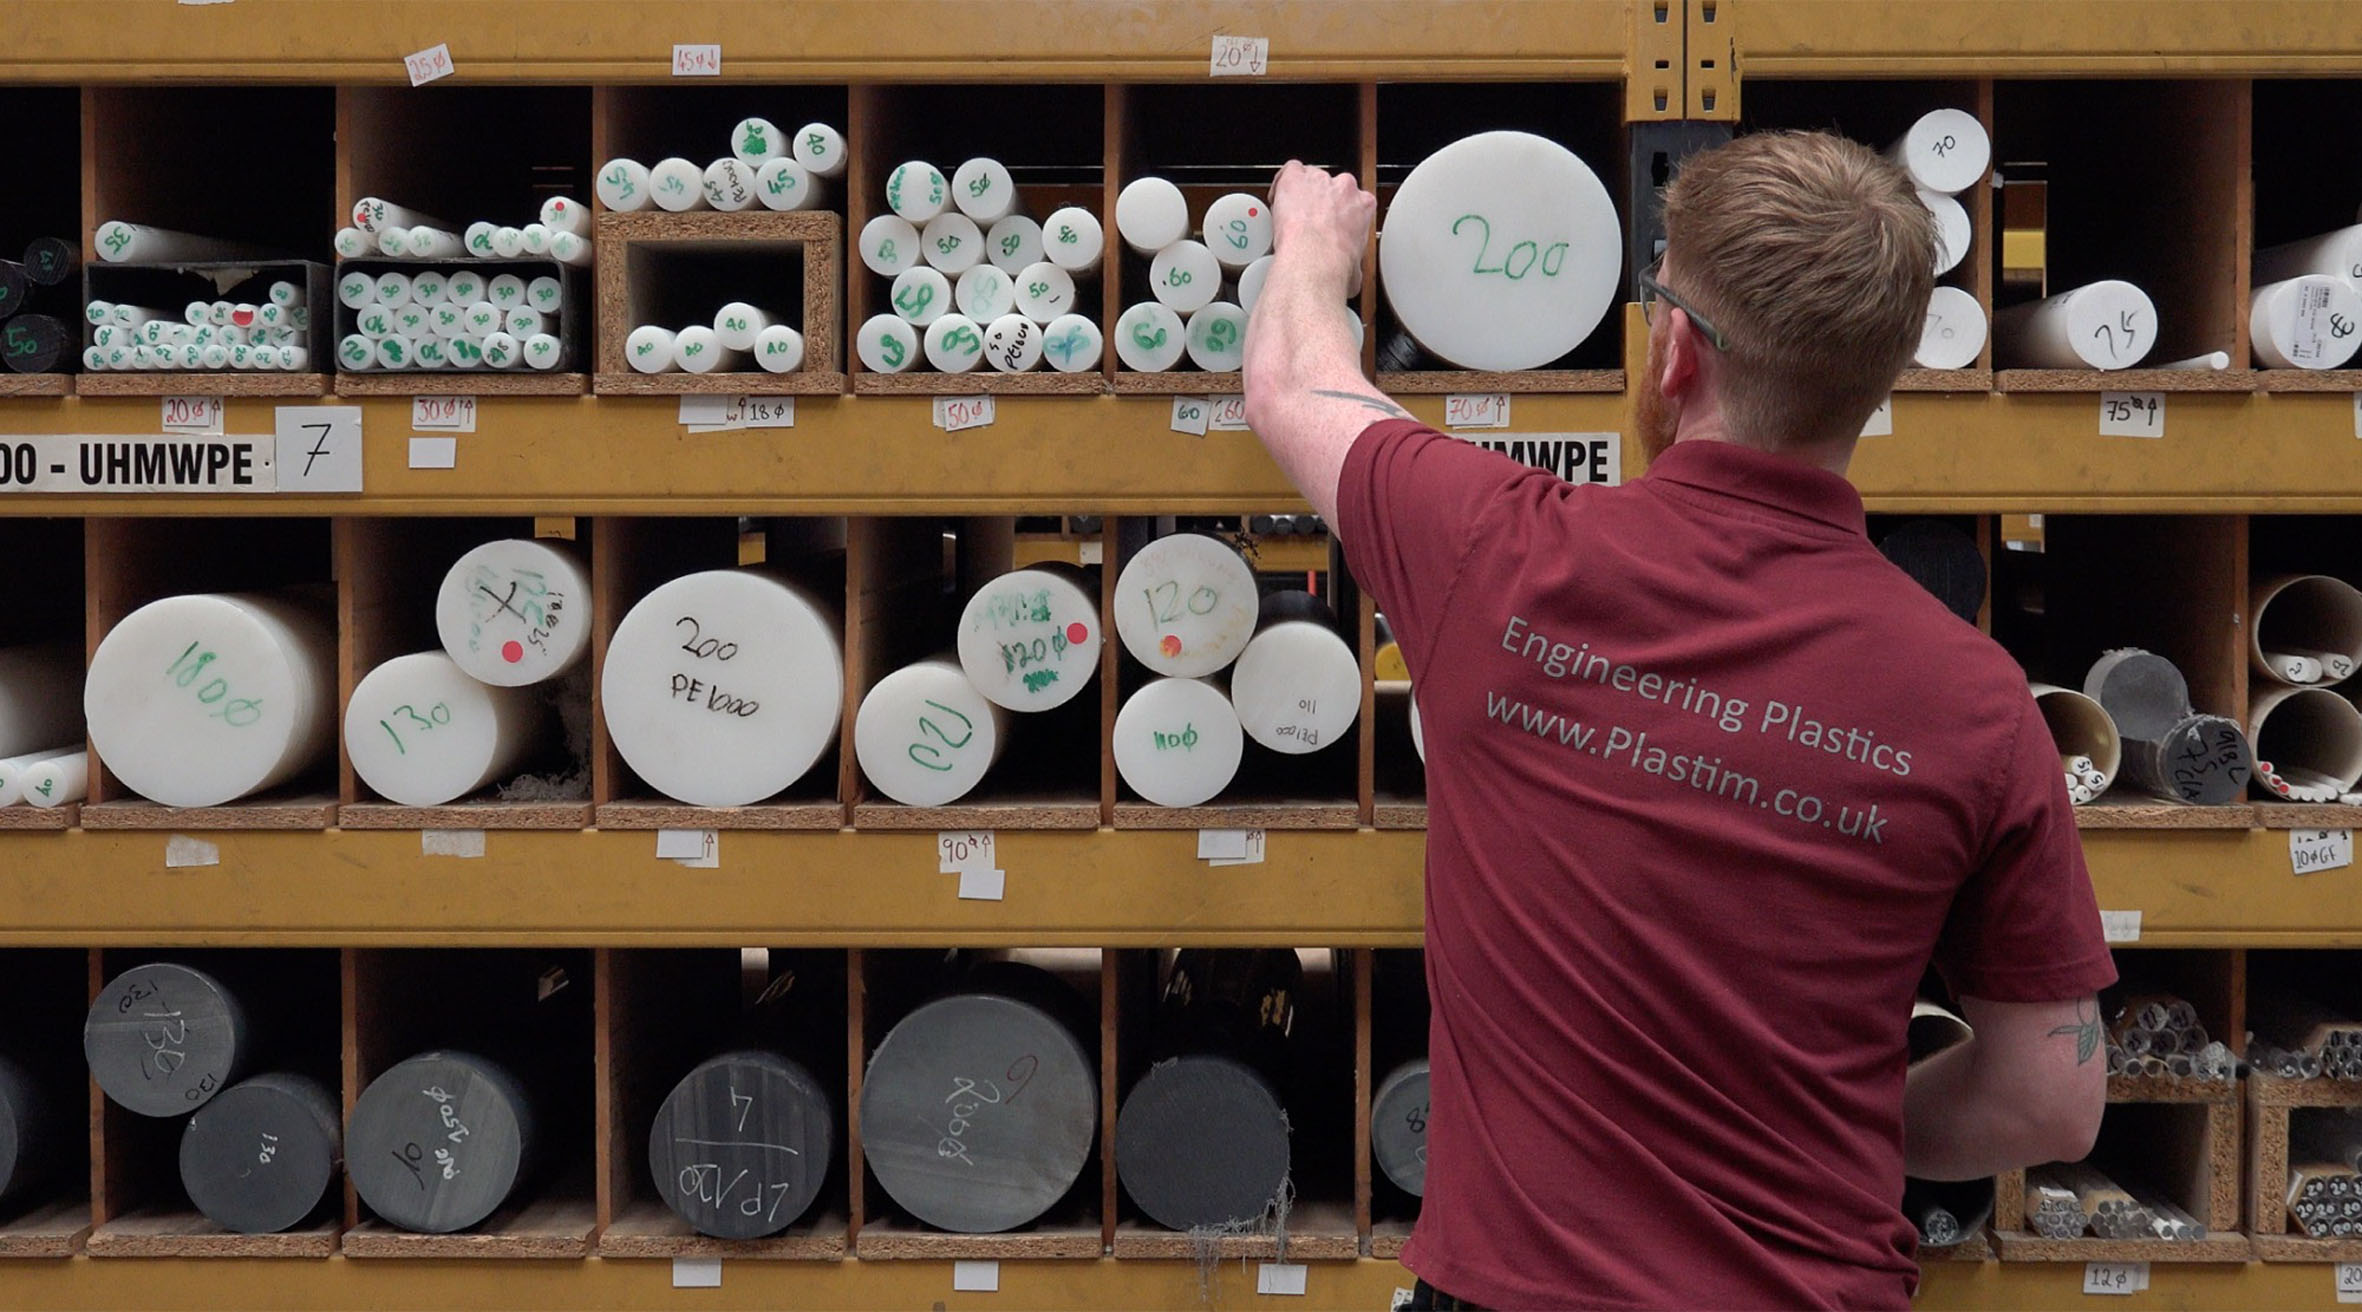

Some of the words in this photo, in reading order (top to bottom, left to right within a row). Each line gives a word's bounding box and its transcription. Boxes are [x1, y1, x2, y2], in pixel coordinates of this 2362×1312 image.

[1933, 135, 1956, 159] 70
[767, 168, 796, 196] 45
[103, 226, 131, 255] 35
[937, 235, 961, 254] 50
[1001, 234, 1020, 256] 50
[1226, 220, 1249, 249] 60
[1452, 215, 1568, 279] 200
[345, 283, 363, 298] 30
[381, 284, 399, 298] 30
[419, 283, 438, 297] 30
[496, 287, 515, 300] 30
[536, 288, 554, 301] 30
[895, 283, 933, 318] 50
[1029, 282, 1049, 299] 50
[88, 308, 104, 320] 20
[403, 314, 419, 327] 30
[439, 311, 455, 325] 30
[473, 313, 490, 326] 30
[513, 317, 533, 330] 30
[5, 326, 37, 357] 50
[532, 342, 550, 354] 30
[1176, 405, 1199, 421] 60
[301, 424, 332, 476] 7
[79, 443, 254, 485] UHMWPE
[1144, 580, 1217, 632] 120
[675, 616, 738, 660] 200
[1500, 615, 1750, 734] Engineering
[1760, 700, 1912, 776] Plastics
[380, 701, 451, 754] 130
[1486, 690, 1889, 843] www.Plastim.co.uk
[118, 980, 158, 1015] 130
[184, 1073, 217, 1102] 130
[259, 1133, 279, 1165] 130
